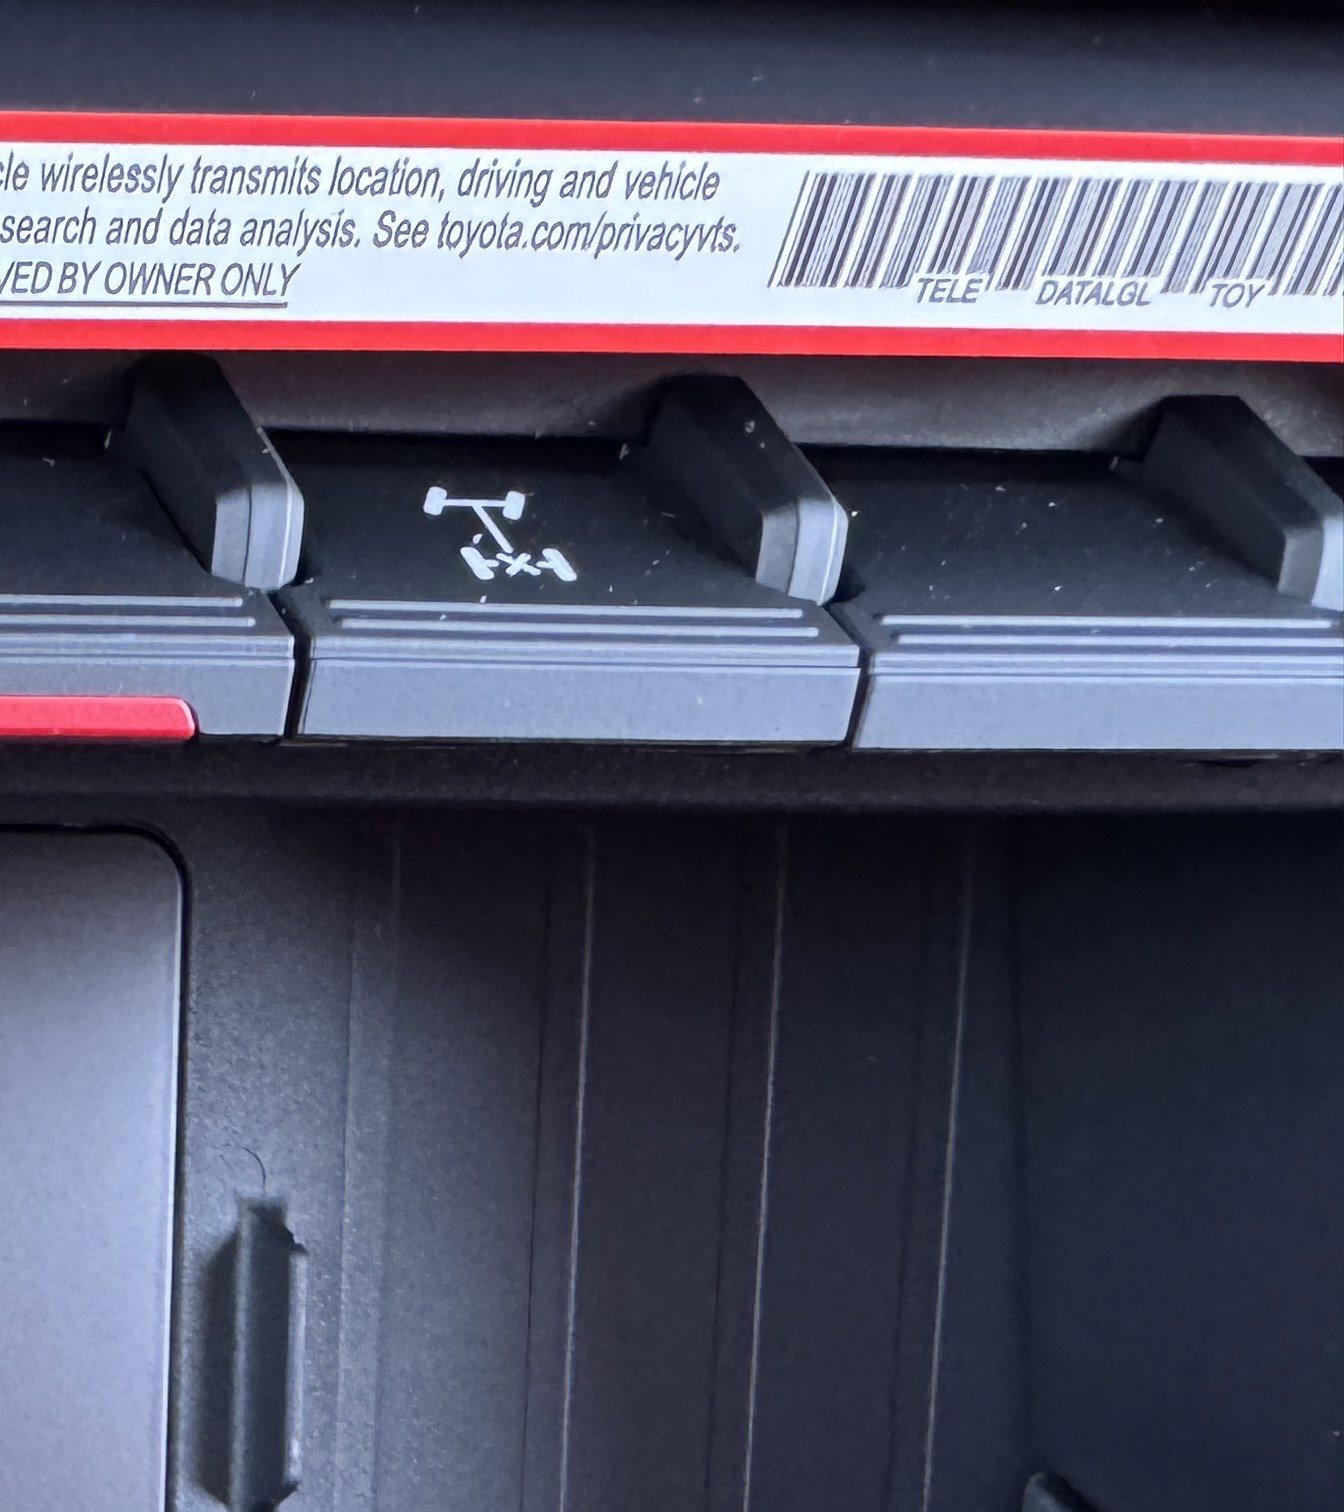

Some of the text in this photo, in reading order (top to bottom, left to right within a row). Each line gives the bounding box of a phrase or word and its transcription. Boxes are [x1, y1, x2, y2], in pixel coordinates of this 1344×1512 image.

[41, 151, 184, 204] wirelessly
[188, 155, 321, 196] transmits
[328, 156, 444, 202] location,
[458, 158, 553, 208] driving
[560, 160, 619, 199] and
[625, 160, 720, 200] vehicle
[106, 208, 163, 246] and
[170, 206, 231, 247] data
[240, 208, 361, 258] analysis.
[373, 210, 429, 248] See
[437, 211, 740, 261] toyota.com/privacyvts.
[58, 261, 101, 295] BY
[104, 261, 216, 296] OWNER
[221, 262, 301, 297] ONLY
[916, 278, 983, 303] TELE
[1209, 283, 1265, 308] TOY
